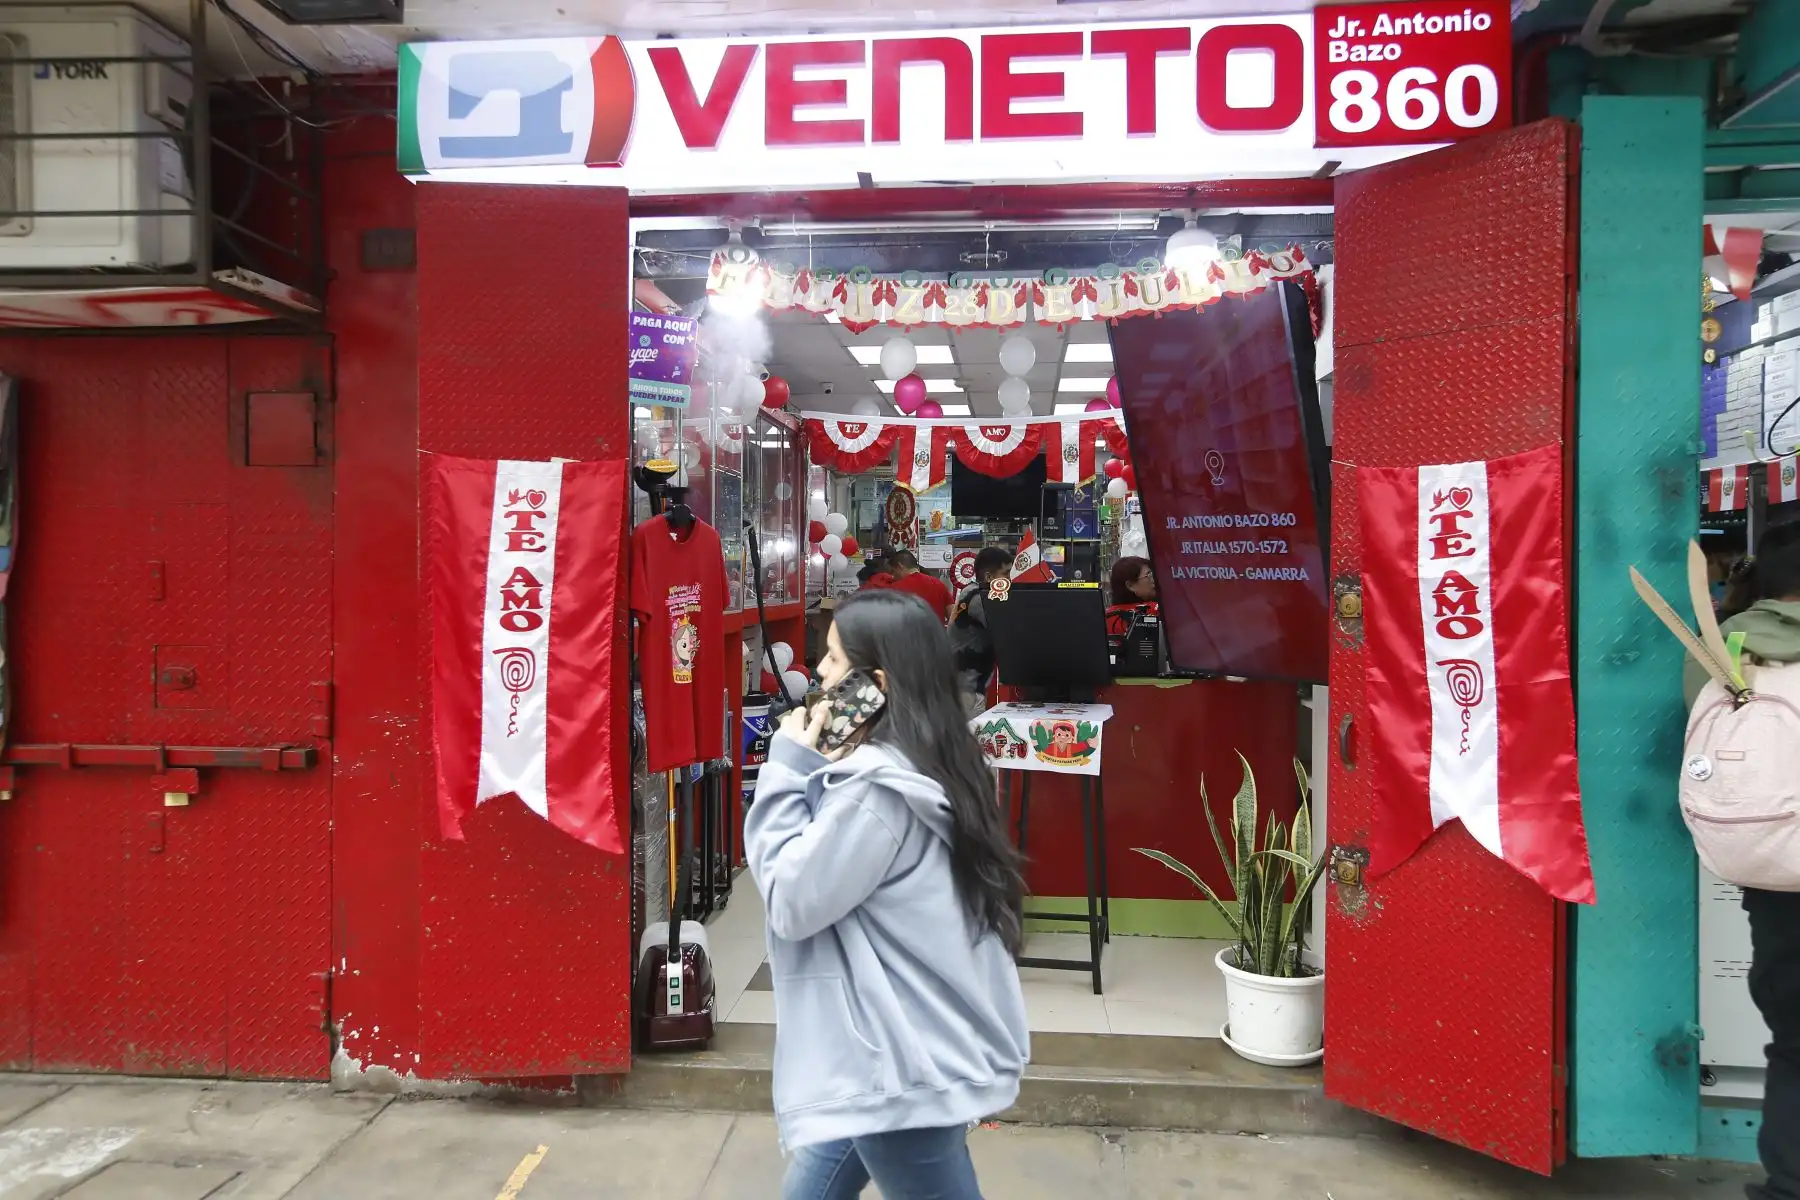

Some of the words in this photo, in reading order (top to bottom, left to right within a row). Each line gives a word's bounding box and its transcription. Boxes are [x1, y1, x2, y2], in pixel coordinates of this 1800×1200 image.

[1328, 16, 1366, 38] Jr.
[1371, 8, 1492, 37] Antonio
[1328, 40, 1402, 63] Bazo
[53, 62, 109, 80] YORK
[646, 23, 1305, 151] VENETO
[1328, 63, 1499, 133] 860
[633, 315, 662, 328] PAGA
[664, 319, 693, 332] AQUÍ
[663, 333, 686, 345] CON
[629, 347, 659, 368] yape
[631, 383, 658, 393] AHORA
[659, 387, 684, 396] TODOS
[844, 424, 860, 433] TE
[1166, 516, 1180, 529] JR.
[1182, 514, 1233, 529] ANTONIO
[1235, 513, 1269, 528] BAZO
[1271, 512, 1297, 527] 860
[503, 510, 547, 553] TE
[1428, 509, 1476, 561] TE
[1193, 540, 1228, 554] ITALIA
[1228, 540, 1289, 554] 1570-1572
[1171, 565, 1186, 579] LA
[1186, 566, 1239, 580] VICTORIA
[1245, 567, 1310, 581] GAMARRA
[500, 566, 544, 633] AMO
[1432, 569, 1484, 640] AMO
